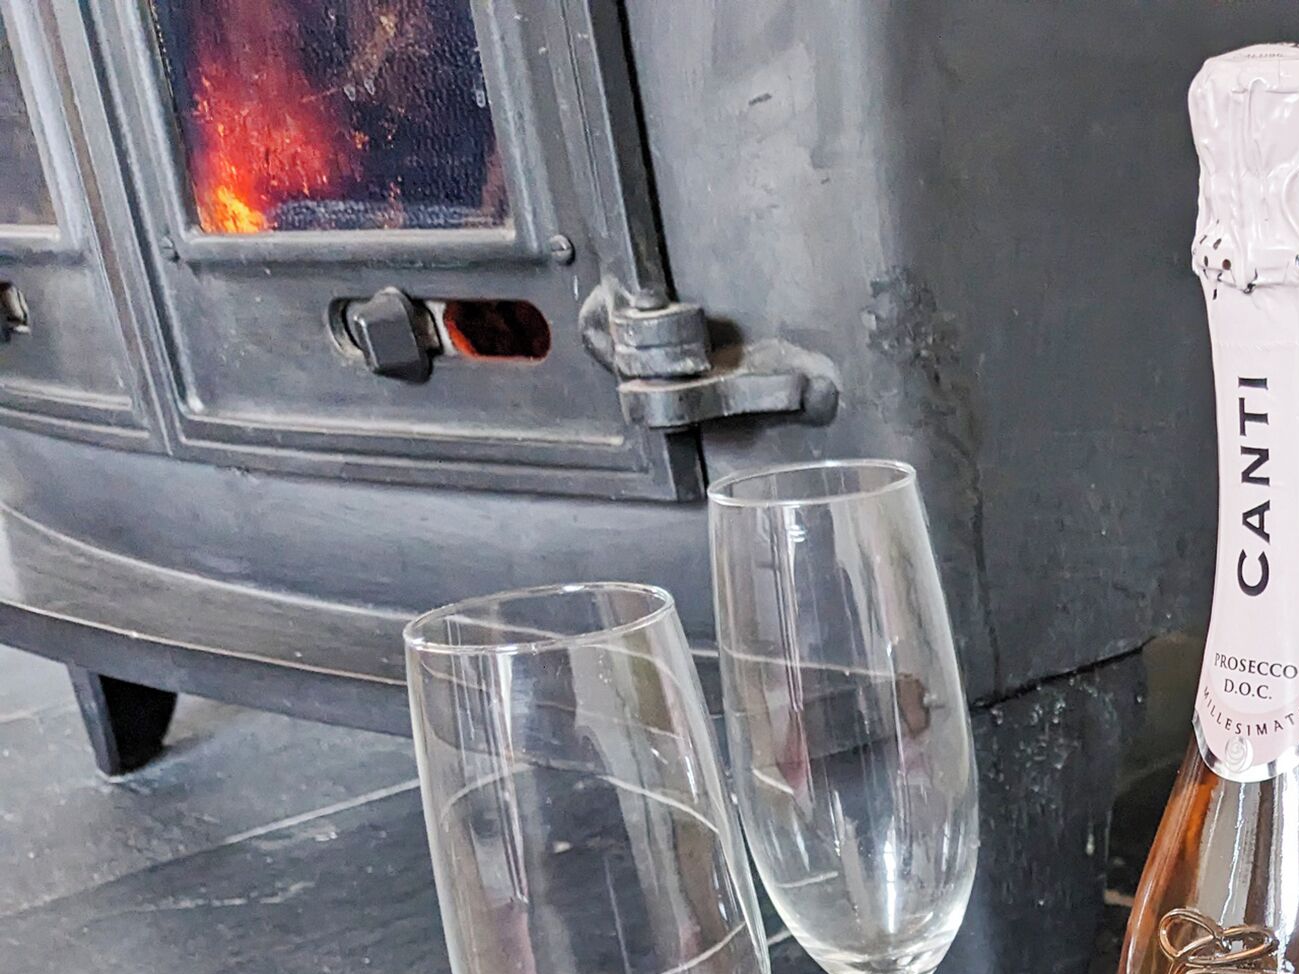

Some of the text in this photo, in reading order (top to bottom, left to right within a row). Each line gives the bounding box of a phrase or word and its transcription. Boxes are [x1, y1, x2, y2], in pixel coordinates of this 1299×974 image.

[1237, 376, 1271, 597] CANTI
[1214, 652, 1298, 679] PROSECCO
[1224, 678, 1272, 699] D.O.C.
